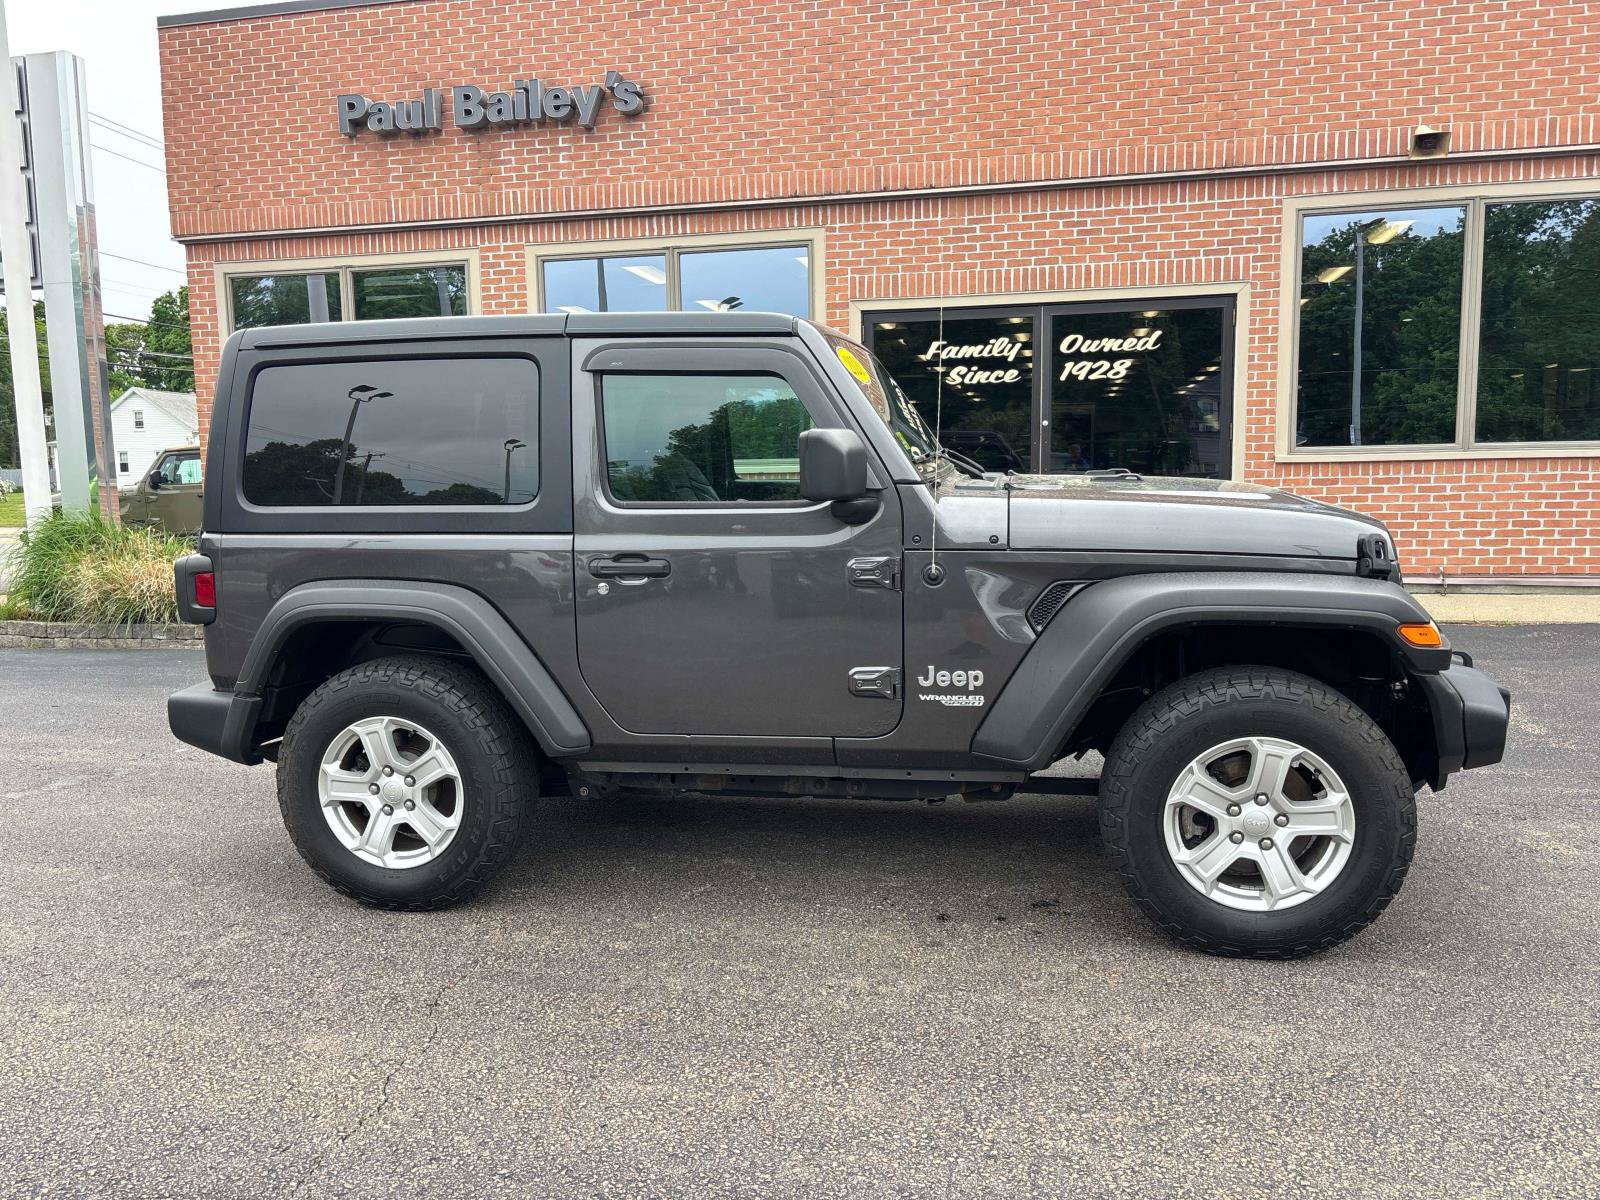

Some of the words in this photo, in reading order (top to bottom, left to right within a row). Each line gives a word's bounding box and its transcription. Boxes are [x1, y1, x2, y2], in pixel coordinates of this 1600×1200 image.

[337, 88, 443, 138] Paul
[452, 71, 646, 130] Bailey's
[925, 337, 1022, 361] Family
[1060, 330, 1163, 354] Owned
[945, 366, 1021, 385] Since
[1060, 359, 1132, 381] 1928
[917, 665, 984, 691] Jeep
